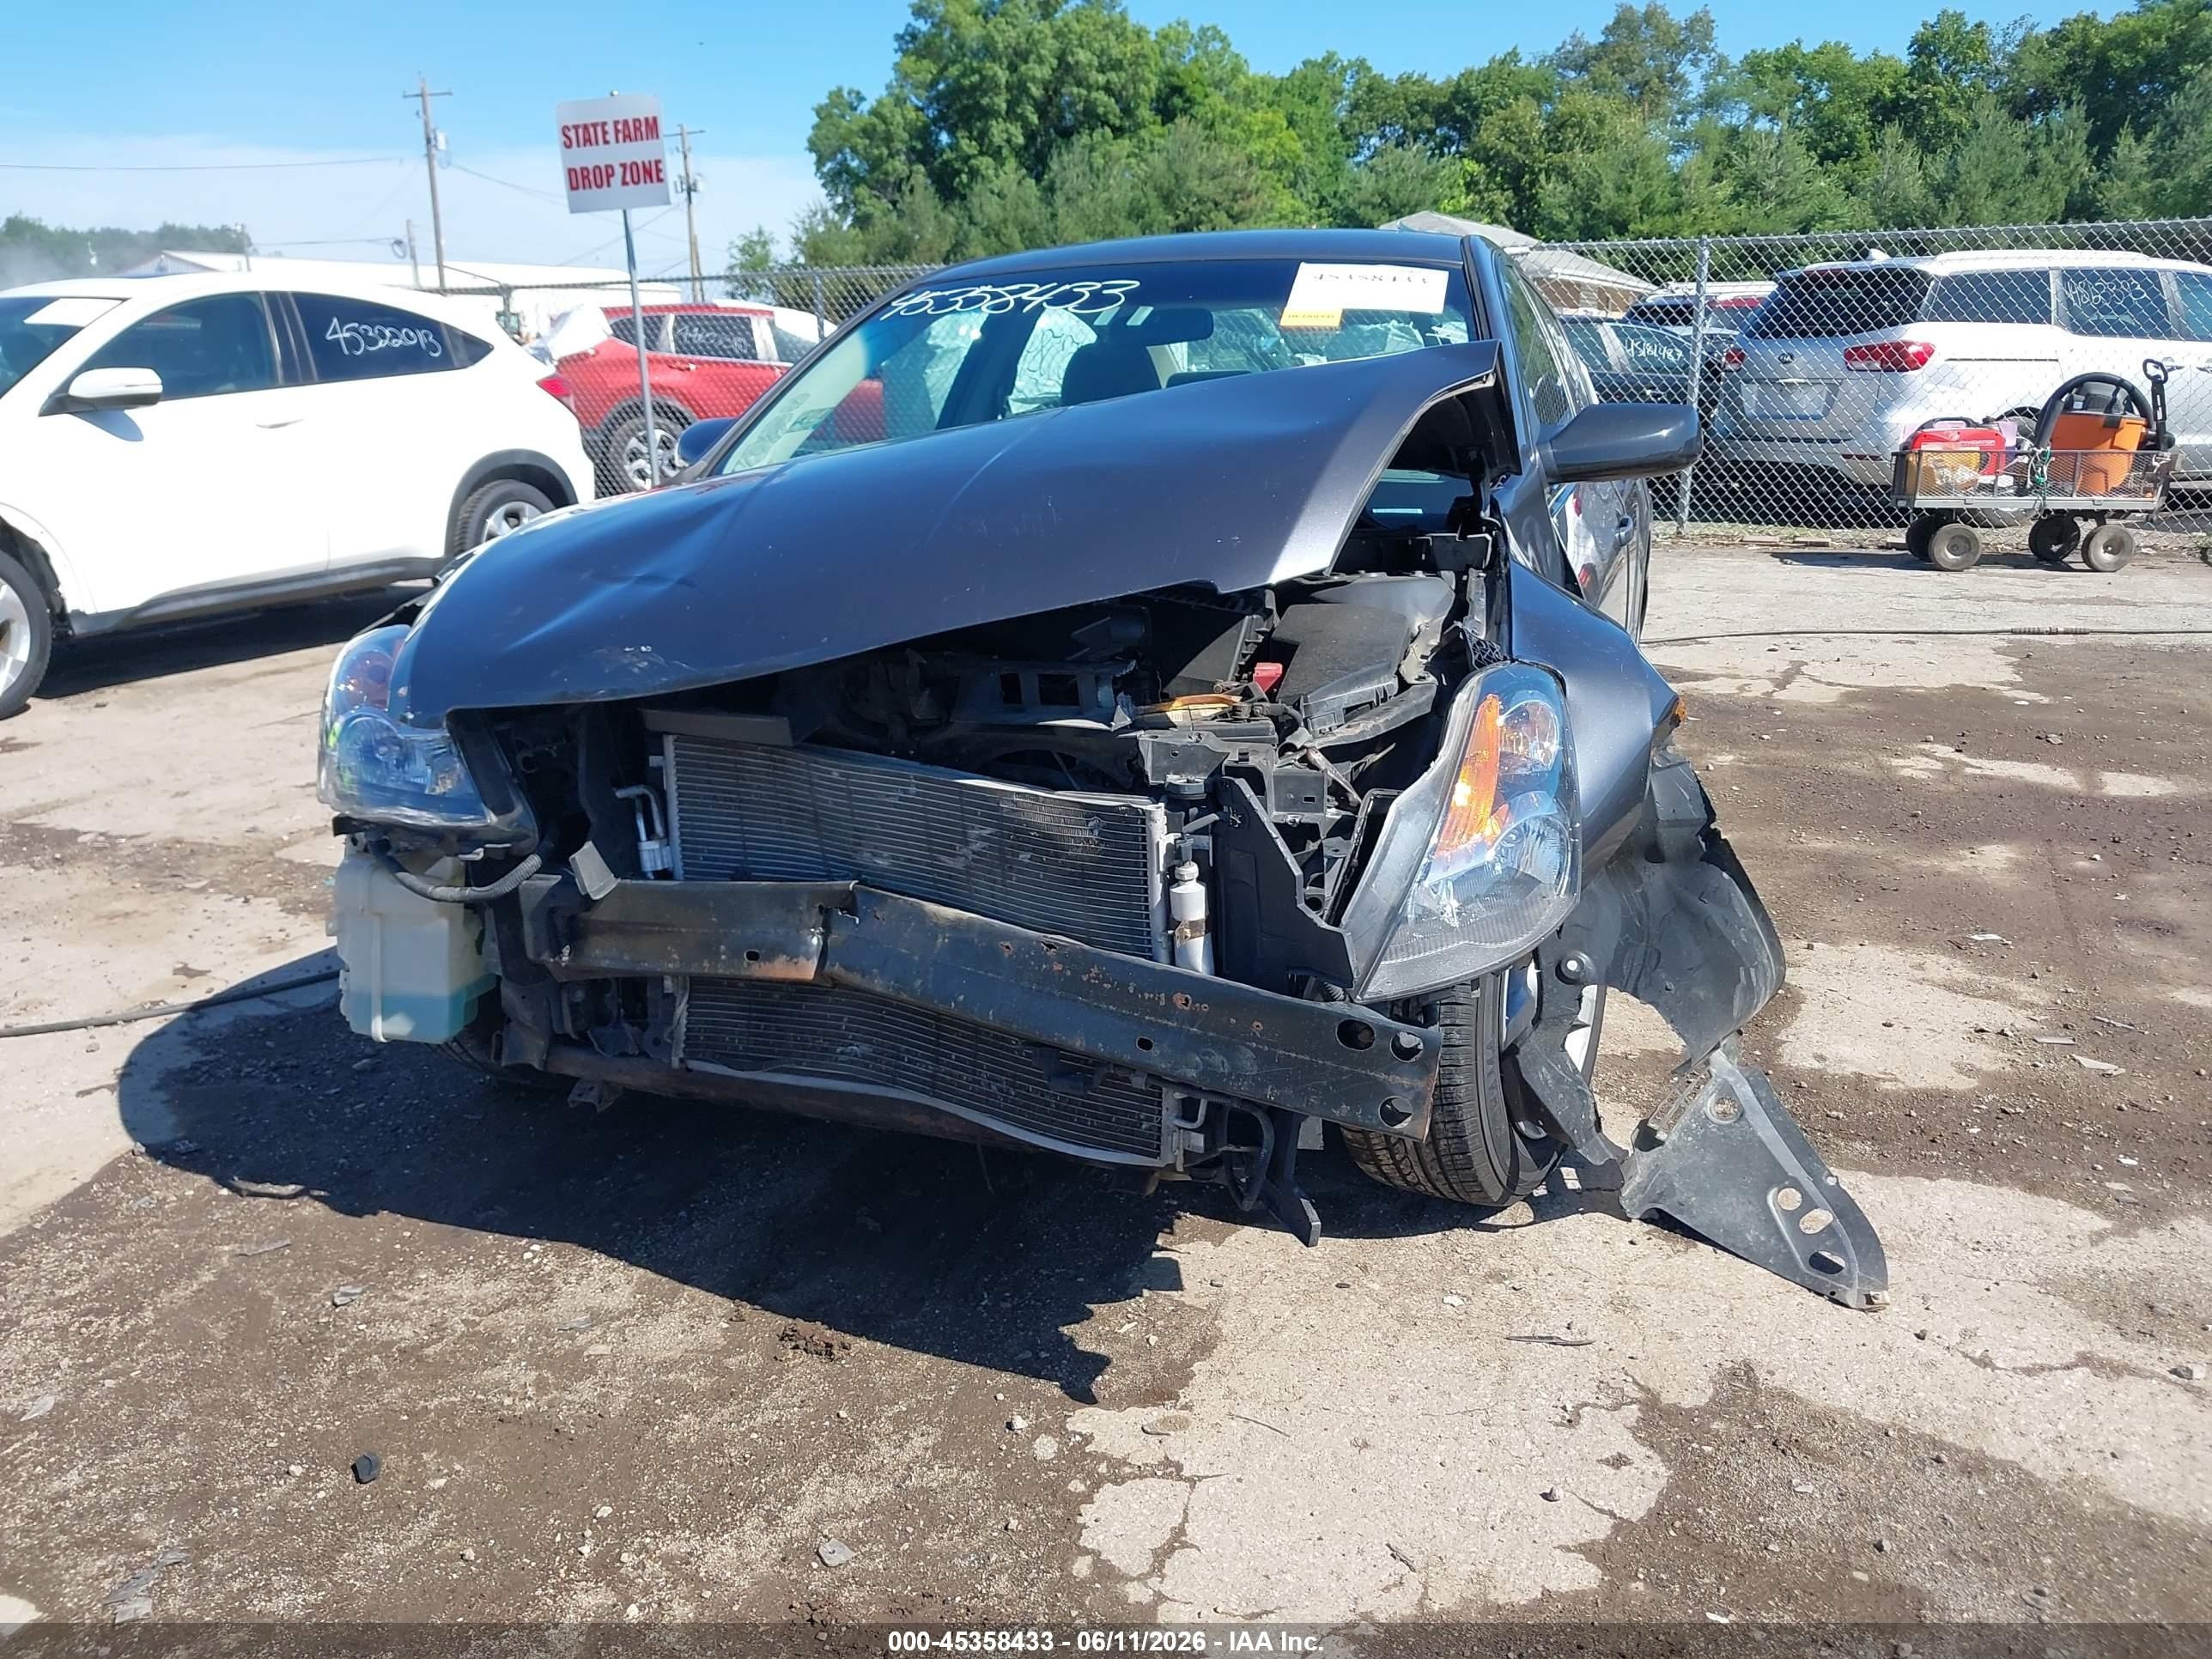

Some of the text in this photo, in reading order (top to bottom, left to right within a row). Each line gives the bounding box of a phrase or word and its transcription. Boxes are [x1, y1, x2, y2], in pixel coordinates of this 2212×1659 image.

[562, 115, 660, 149] STATE FARM
[567, 158, 665, 191] DROP ZONE
[325, 316, 443, 357] 45322013
